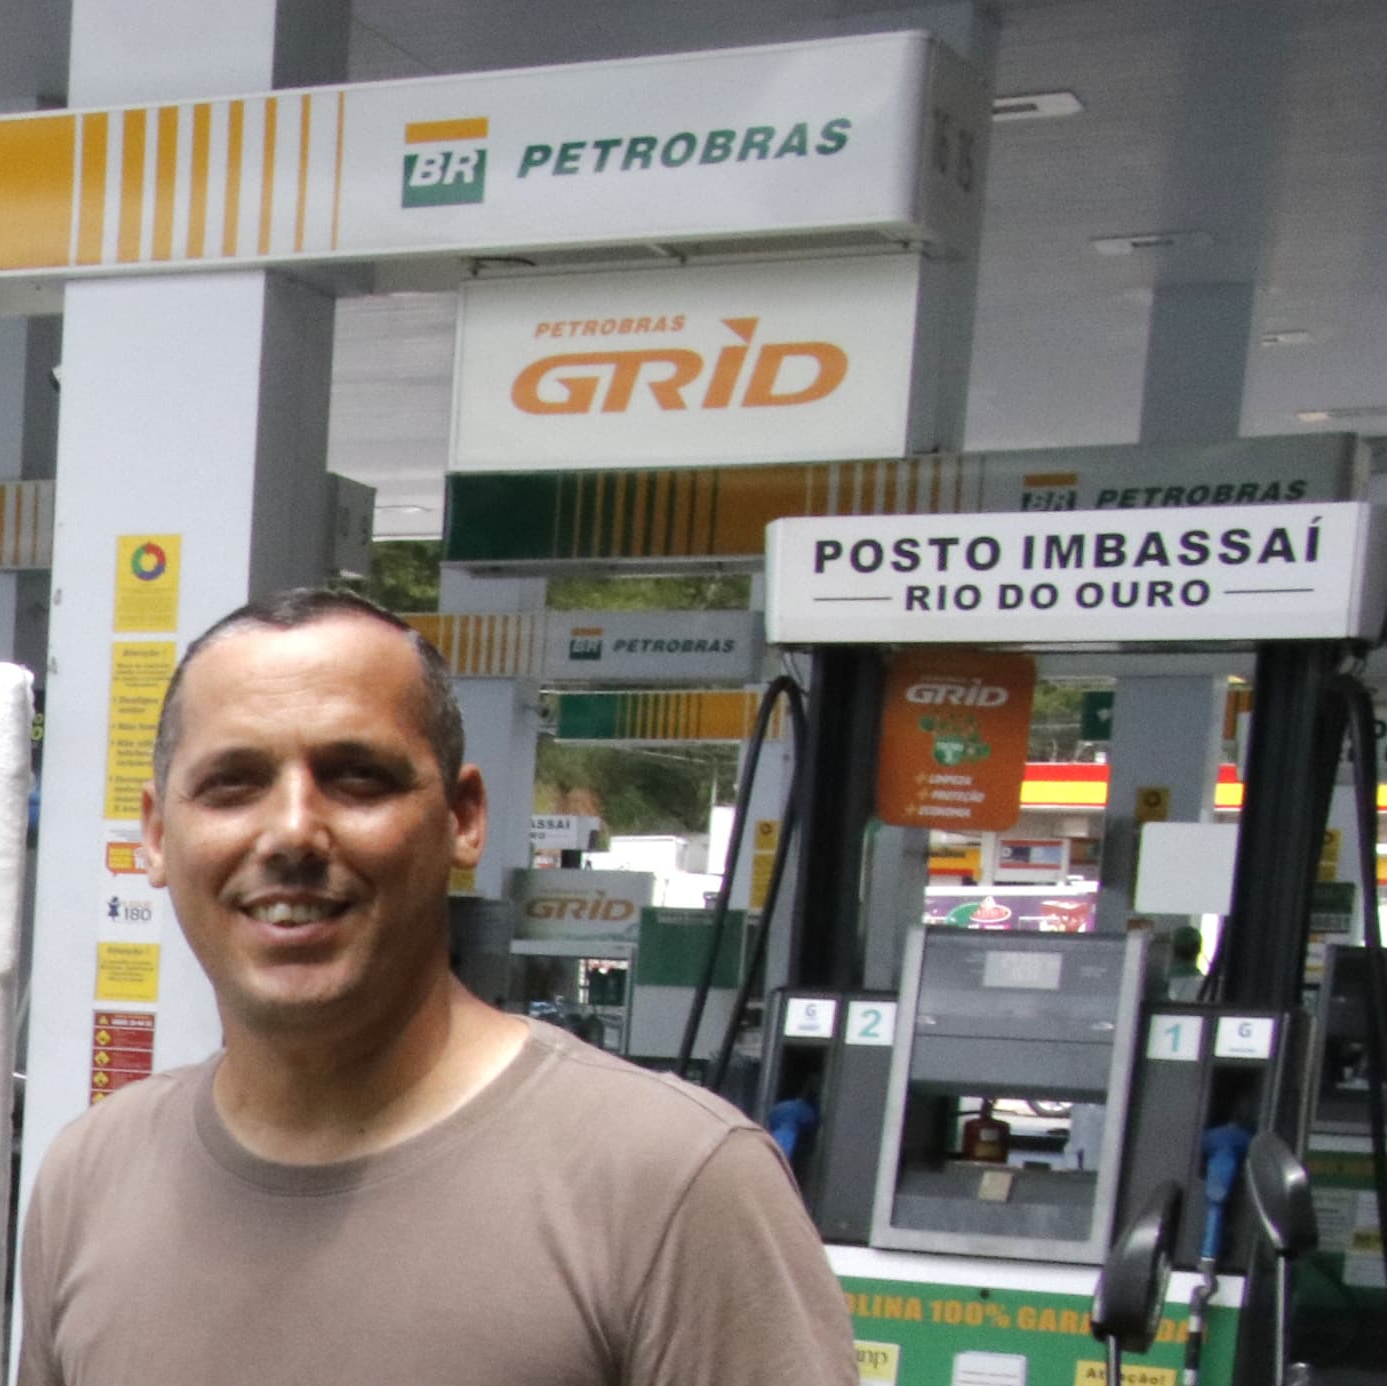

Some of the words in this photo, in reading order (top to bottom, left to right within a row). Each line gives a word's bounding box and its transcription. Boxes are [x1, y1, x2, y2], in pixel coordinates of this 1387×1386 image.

[406, 150, 486, 187] BR
[517, 118, 851, 179] PETROBRAS
[534, 315, 686, 338] PETROBRAS
[510, 317, 848, 415] GRID
[1096, 480, 1308, 510] PETROBRAS
[813, 536, 1002, 574] POSTO
[1021, 516, 1323, 570] IMBASSAÍ
[905, 584, 982, 612] RIO
[997, 582, 1058, 610] DO
[1074, 579, 1211, 609] OURO
[612, 638, 735, 654] PETROBRAS
[905, 677, 1009, 707] GRID
[859, 1008, 882, 1038] 2
[1165, 1023, 1182, 1052] 1
[931, 1299, 1011, 1329] 100%
[1086, 1367, 1166, 1386] Atção!
